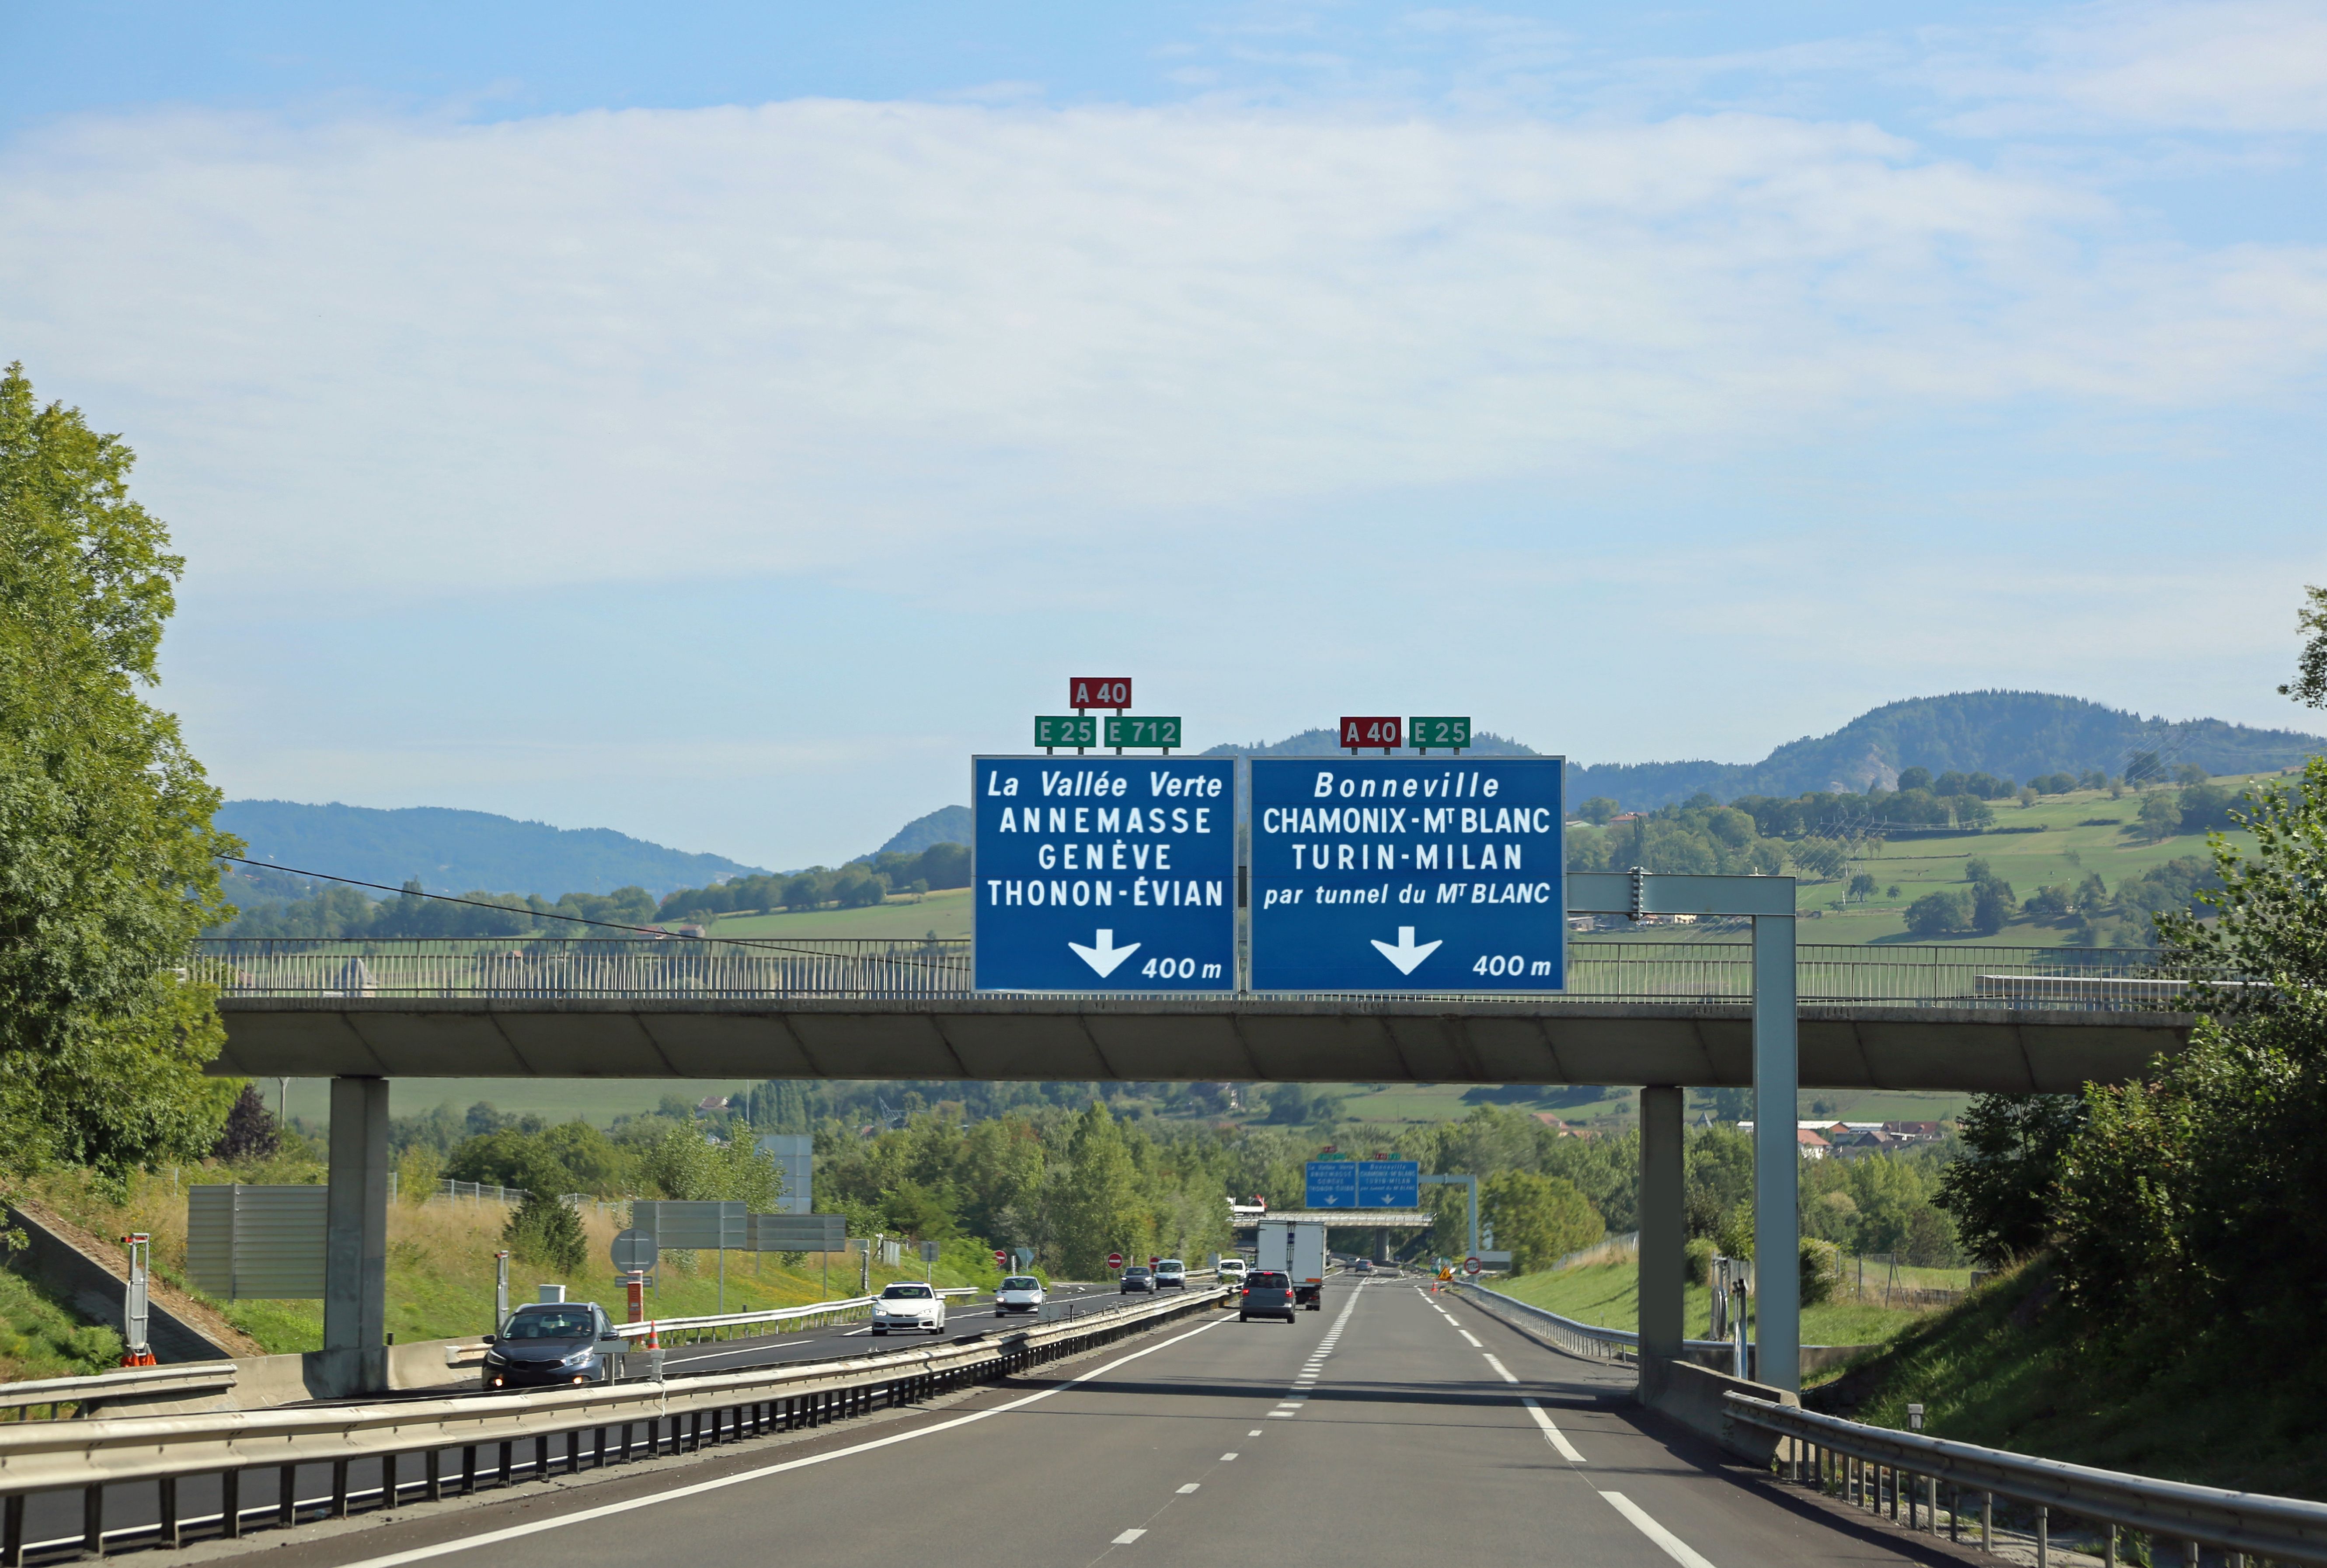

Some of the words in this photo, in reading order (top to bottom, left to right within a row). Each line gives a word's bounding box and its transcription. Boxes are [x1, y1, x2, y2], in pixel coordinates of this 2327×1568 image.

[1076, 683, 1090, 703] A
[1097, 683, 1126, 703] 40
[1041, 721, 1052, 741] E
[1061, 722, 1091, 742] 25
[1110, 722, 1121, 741] E
[1132, 722, 1176, 742] 712
[1346, 722, 1360, 742] A
[1367, 722, 1396, 742] 40
[1415, 722, 1426, 742] E
[1435, 722, 1465, 742] 25
[988, 771, 1018, 796] La
[1042, 771, 1127, 796] Vallée
[1151, 771, 1222, 797] Verte
[1314, 772, 1498, 798] Bonneville
[1000, 807, 1210, 833] ANNEMASSE
[1462, 808, 1550, 833] BLANC
[1039, 839, 1170, 869] GENÈVE
[1292, 844, 1521, 869] TURIN-MILAN
[987, 876, 1222, 906] THONON-ÉVIAN
[1264, 889, 1303, 909] par
[1316, 883, 1388, 904] tunnel
[1399, 883, 1426, 904] du
[1471, 883, 1550, 903] BLANC
[1142, 958, 1195, 979] 400
[1202, 964, 1221, 978] m
[1473, 955, 1524, 976] 400
[1531, 961, 1551, 976] m
